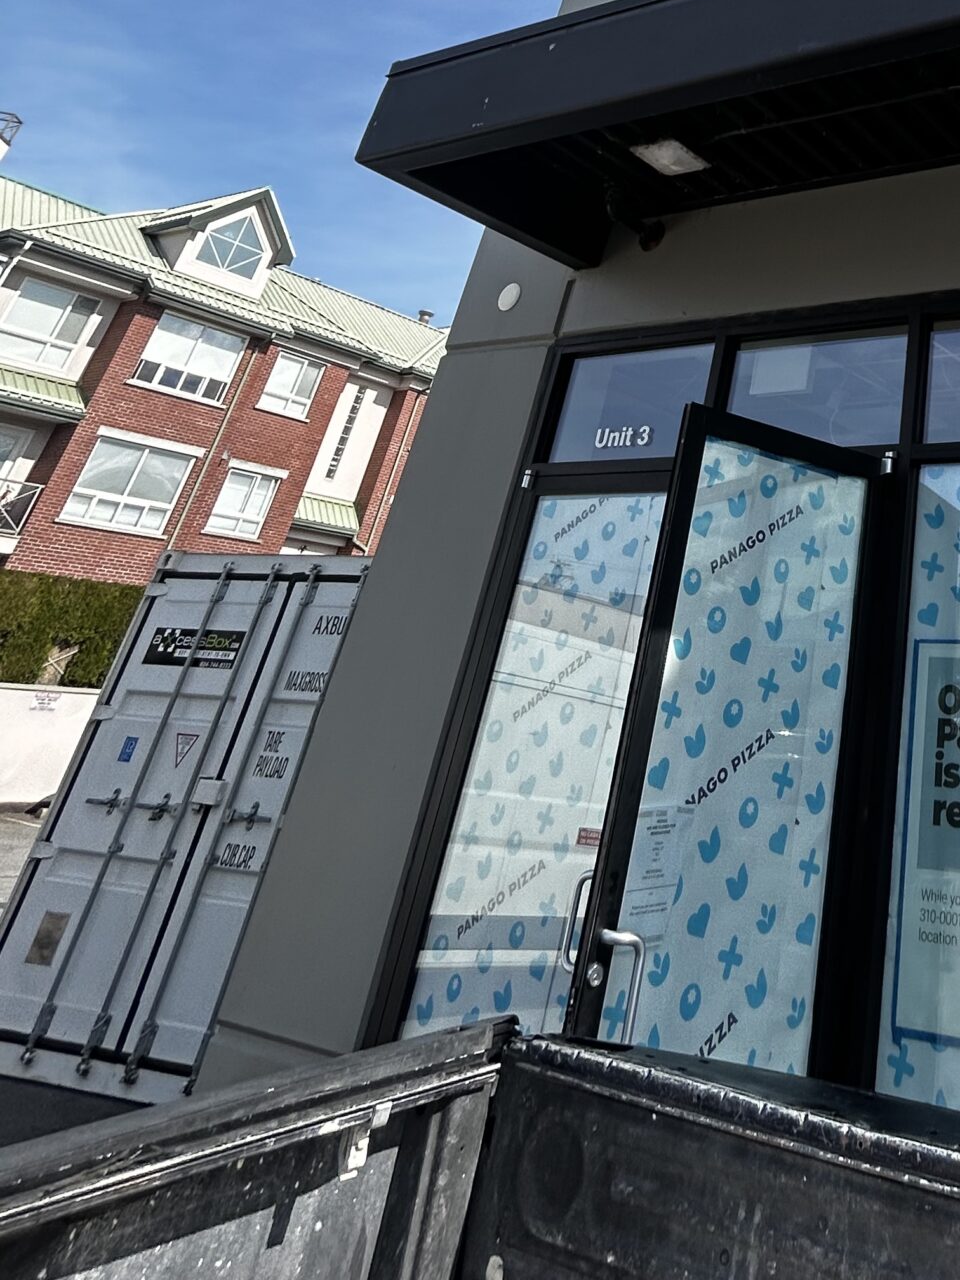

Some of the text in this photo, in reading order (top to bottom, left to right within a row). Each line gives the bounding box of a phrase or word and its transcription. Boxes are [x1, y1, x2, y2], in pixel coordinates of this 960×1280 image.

[595, 425, 650, 448] Unit 3
[553, 503, 597, 542] PANAGO
[710, 504, 804, 574] PANAGO PIZZA
[312, 615, 348, 635] AXBU
[512, 650, 593, 722] PANAGO PIZZA
[263, 730, 285, 753] TARE
[731, 728, 775, 773] PIZZA
[252, 755, 289, 779] PAYLOAD
[934, 751, 960, 789] is
[457, 859, 546, 940] PANAGO PIZZA
[921, 888, 948, 905] While
[918, 927, 958, 946] location
